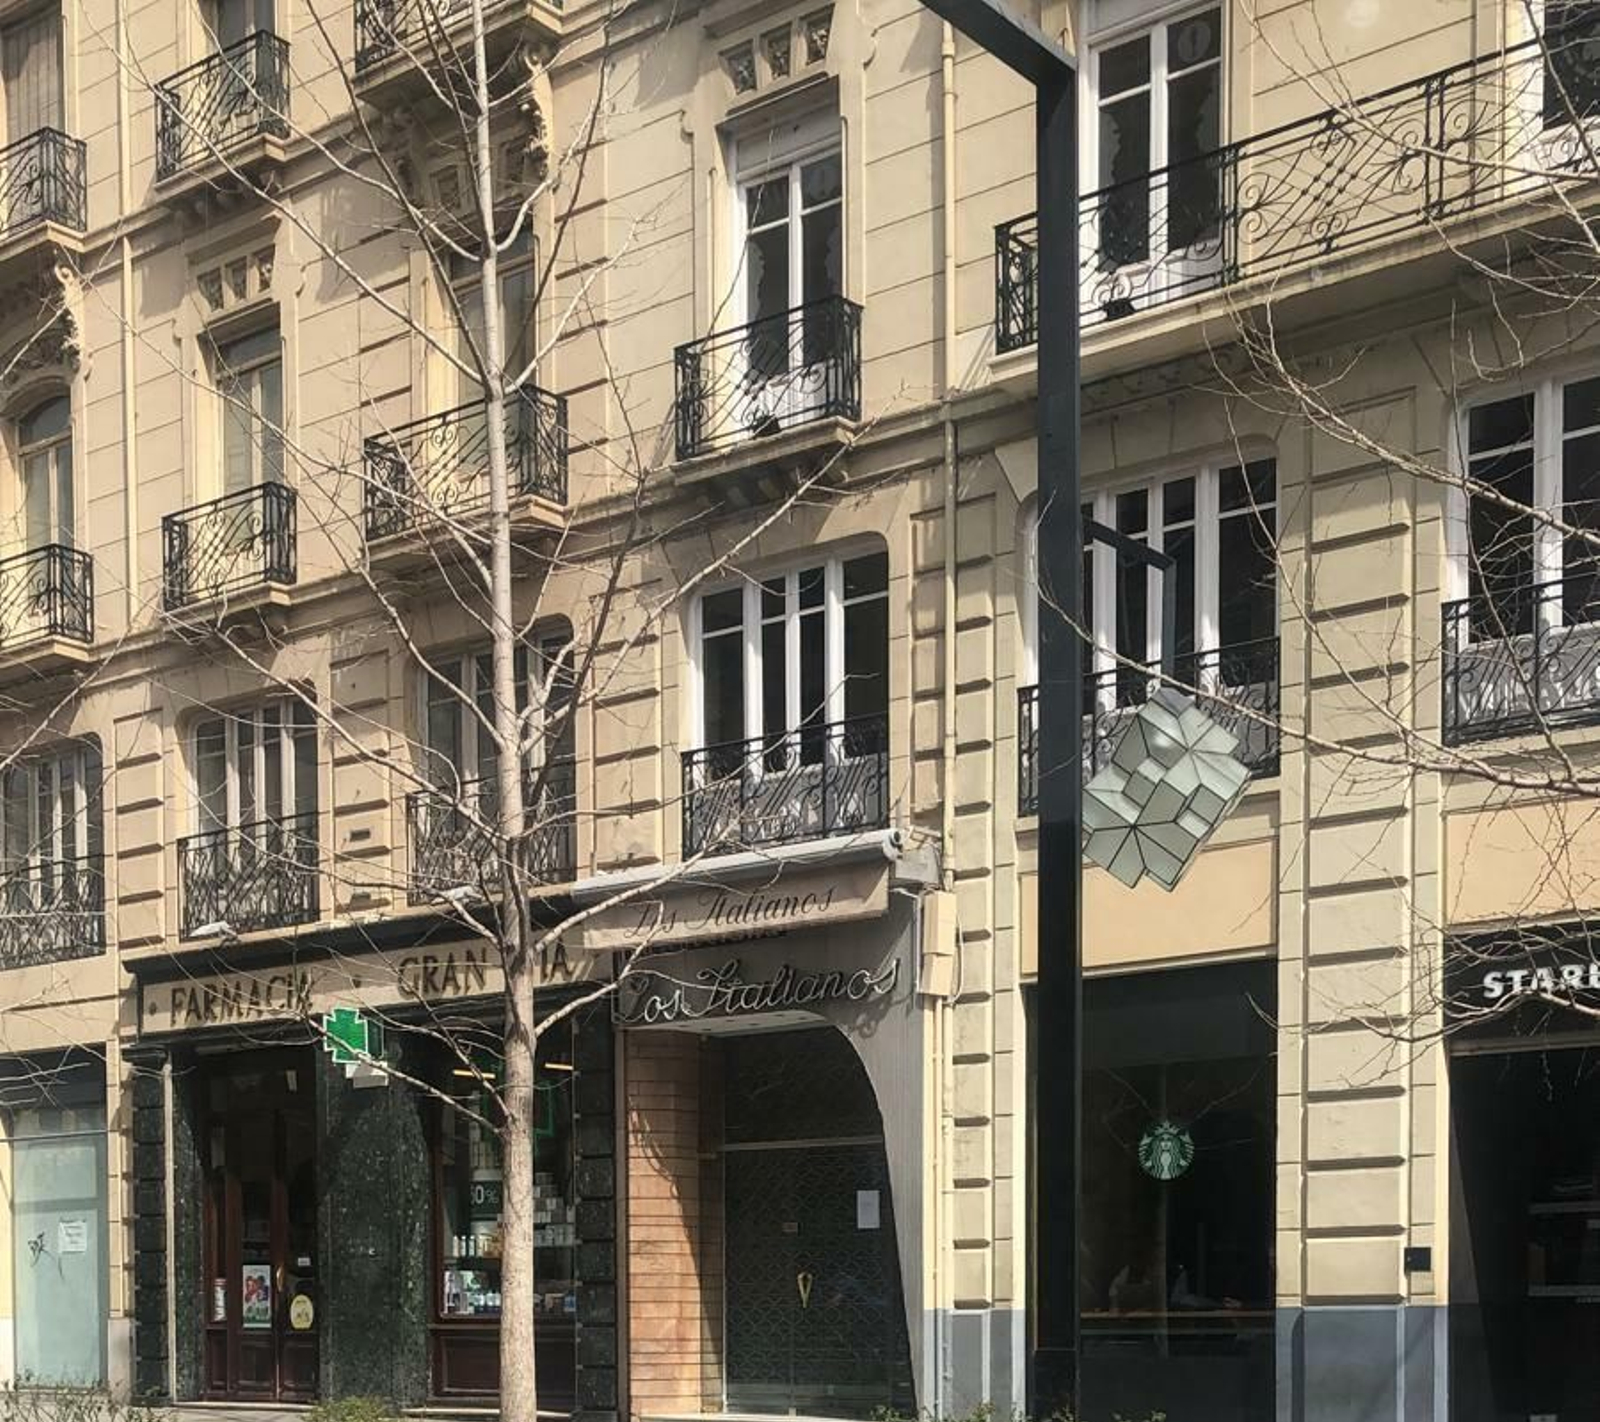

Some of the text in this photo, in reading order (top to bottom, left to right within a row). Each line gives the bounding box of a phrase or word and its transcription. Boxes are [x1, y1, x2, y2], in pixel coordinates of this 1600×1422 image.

[684, 885, 836, 930] Italianos
[399, 948, 488, 997] GRAN
[682, 959, 899, 1016] Italianos
